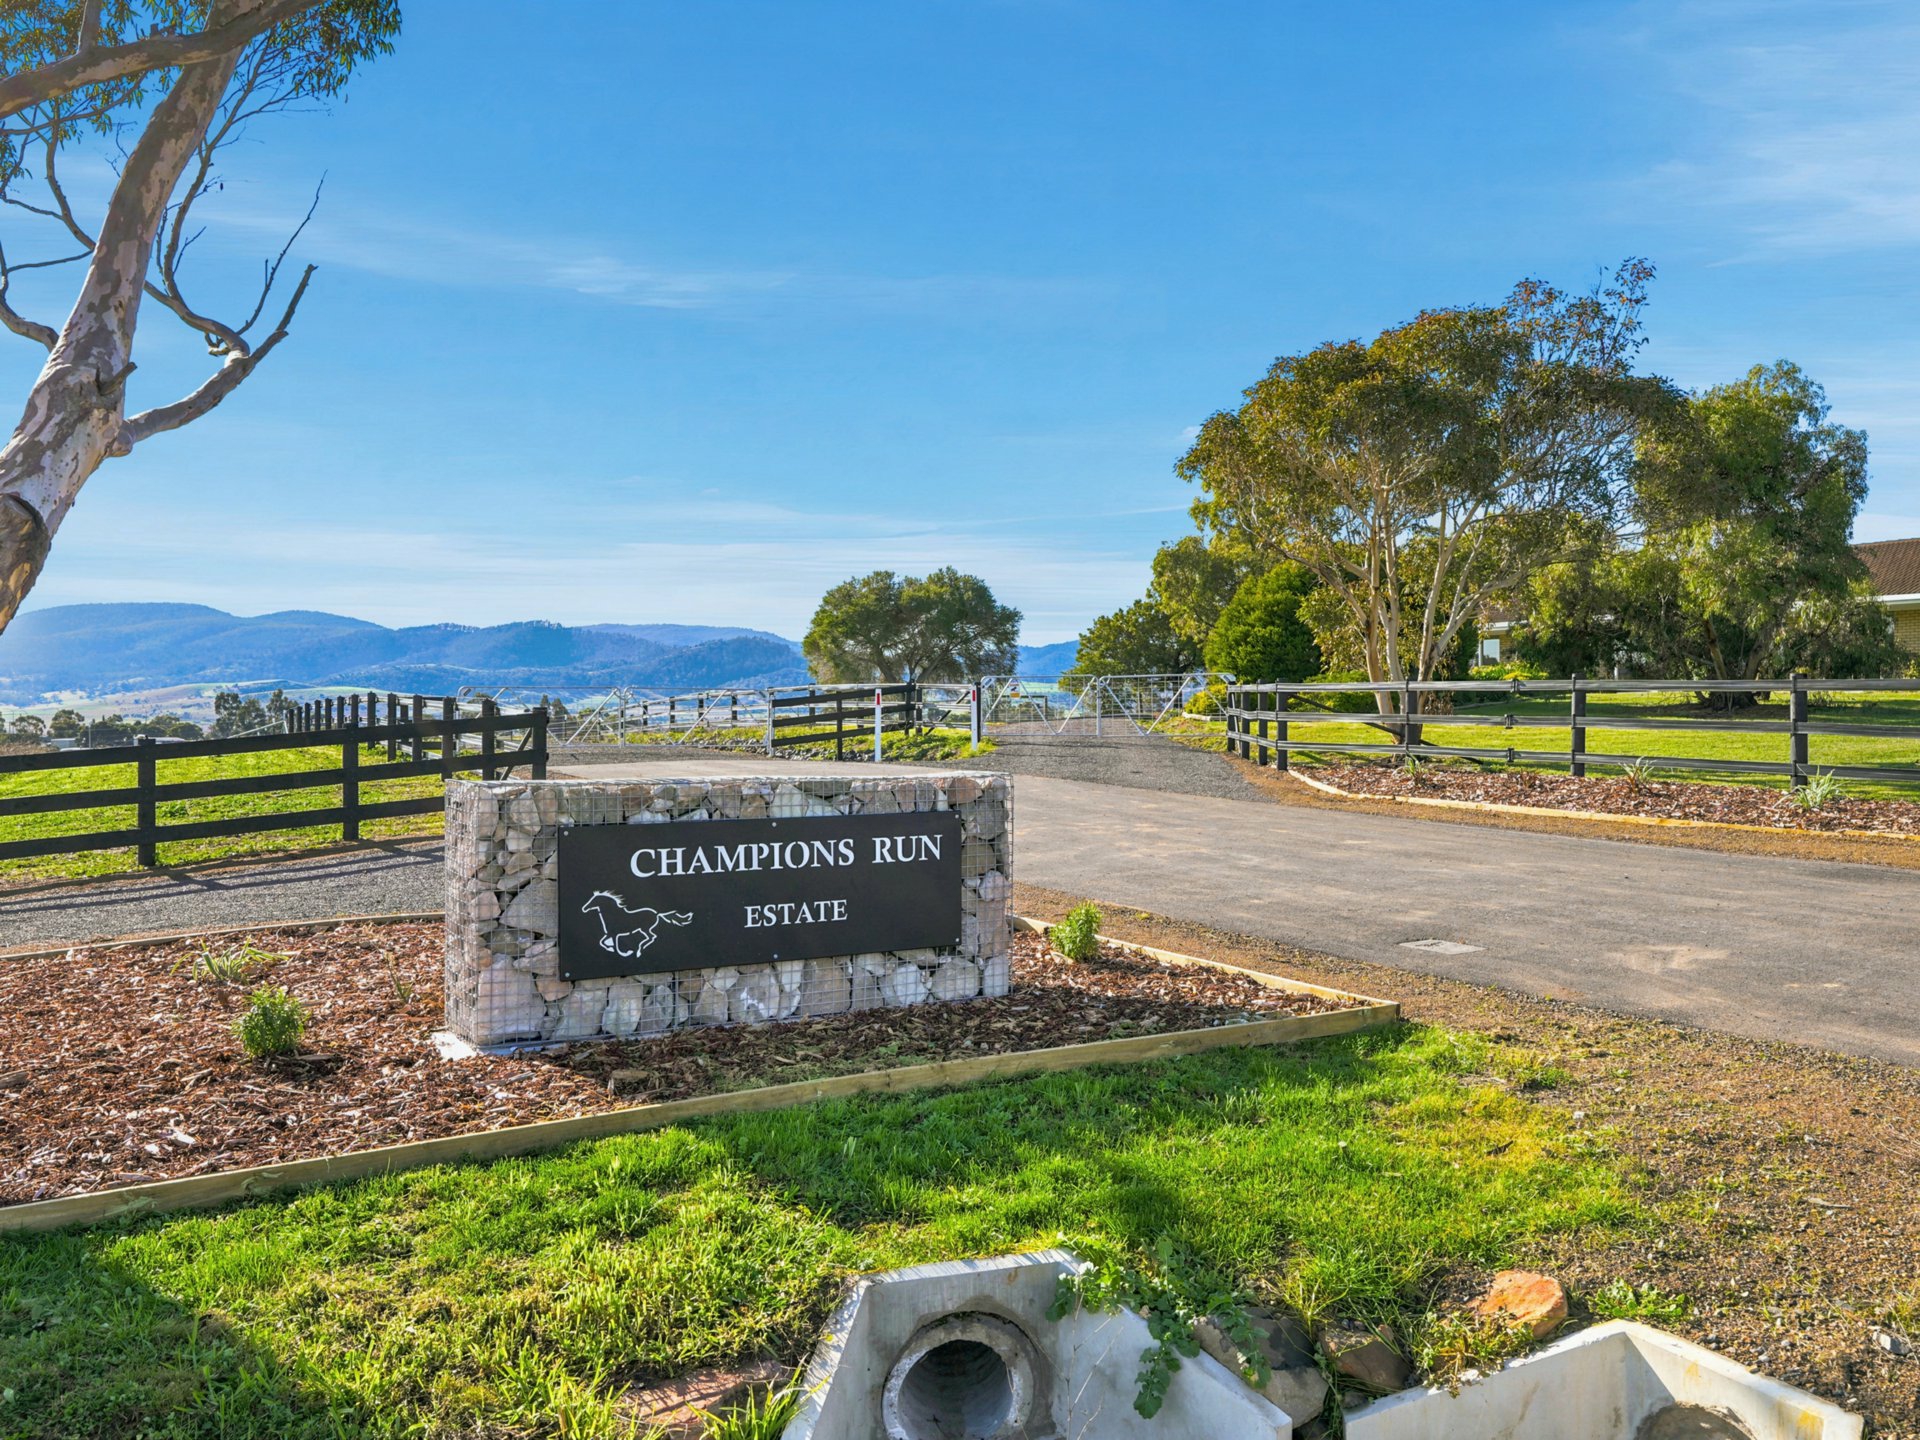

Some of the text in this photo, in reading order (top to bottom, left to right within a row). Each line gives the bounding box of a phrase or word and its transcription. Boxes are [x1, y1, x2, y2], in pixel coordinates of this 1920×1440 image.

[630, 834, 943, 878] CHAMPIONS RUN
[744, 899, 848, 928] ESTATE
